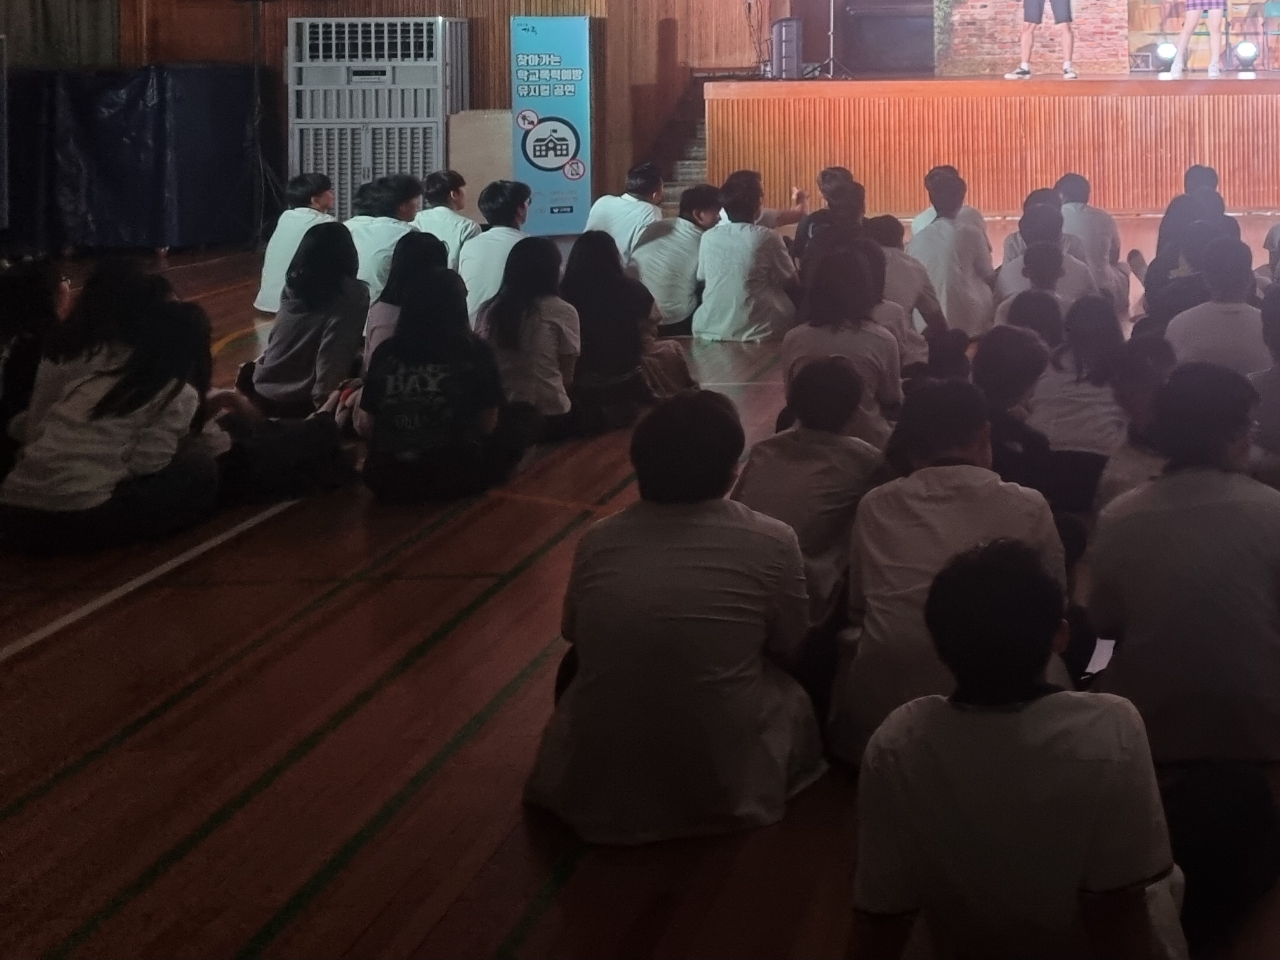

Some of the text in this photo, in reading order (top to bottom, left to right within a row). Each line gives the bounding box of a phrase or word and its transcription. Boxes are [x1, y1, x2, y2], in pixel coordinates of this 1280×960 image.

[516, 53, 562, 67] 찾아가는
[516, 68, 584, 82] 학교폭력예방
[517, 83, 576, 97] 뮤지컬 공연
